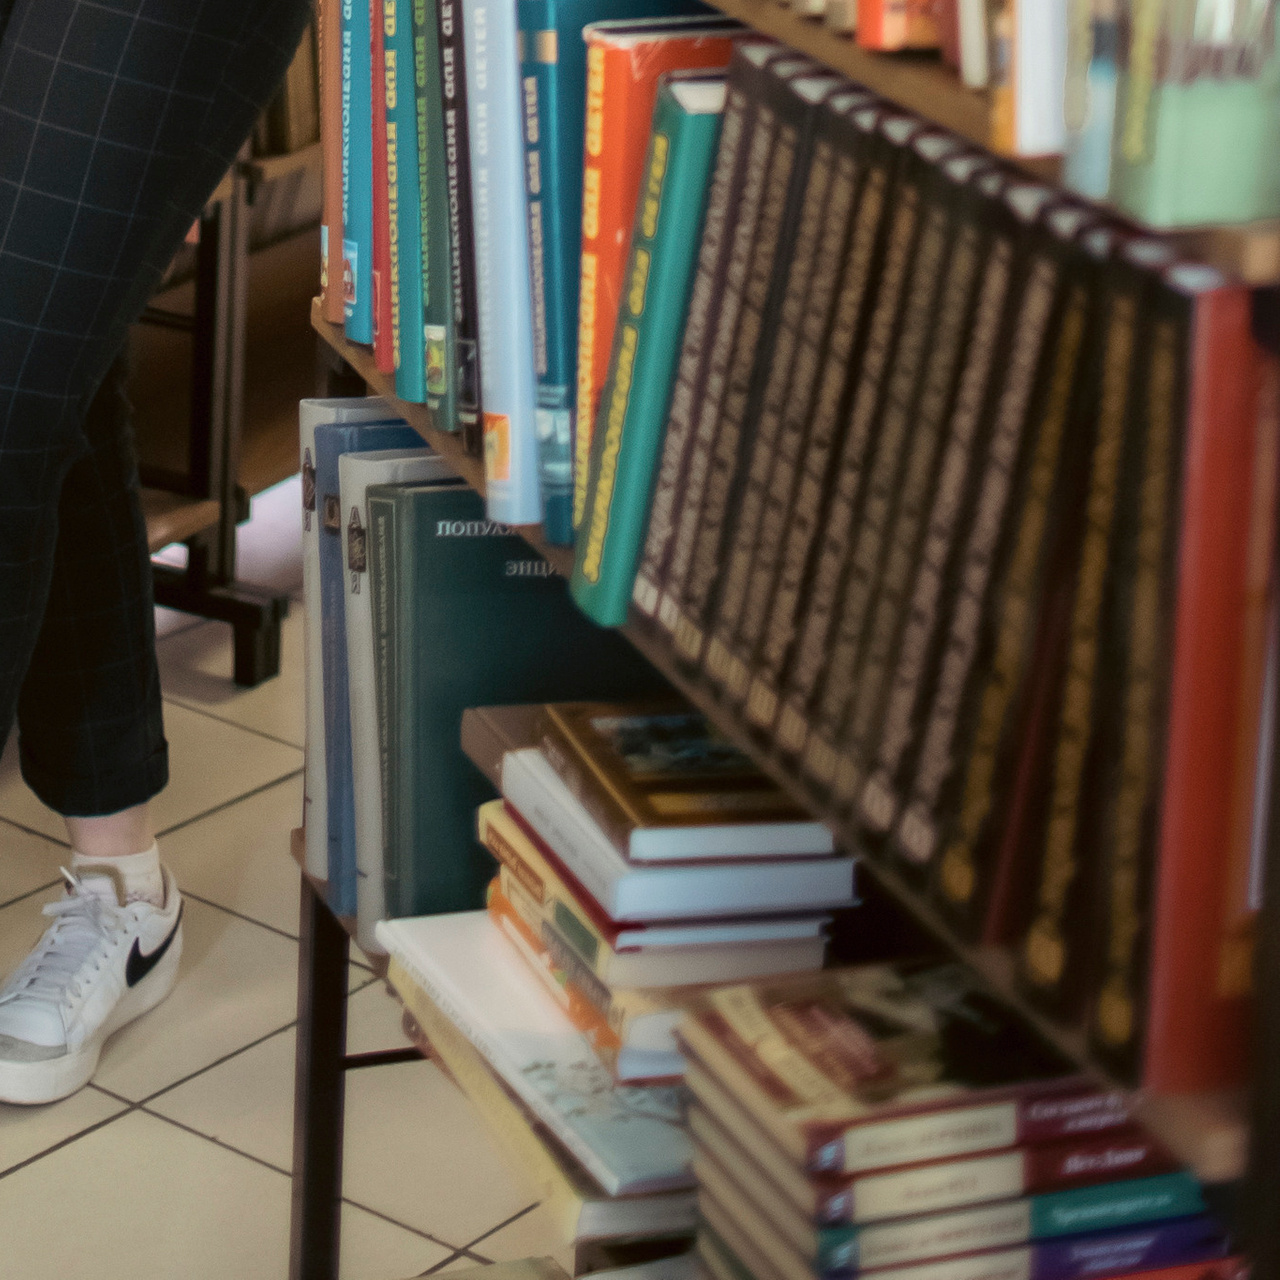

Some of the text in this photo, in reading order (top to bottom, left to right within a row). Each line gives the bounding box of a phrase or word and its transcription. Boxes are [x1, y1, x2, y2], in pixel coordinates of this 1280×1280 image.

[383, 49, 397, 110] ДЛЯ
[442, 47, 455, 99] ДЛЯ
[385, 121, 400, 369] ЭНЦИКЛОПЕДИЯ
[443, 109, 463, 322] ЭНЦИКЛОПЕДИЯ
[504, 560, 560, 577] ЭНЦИ
